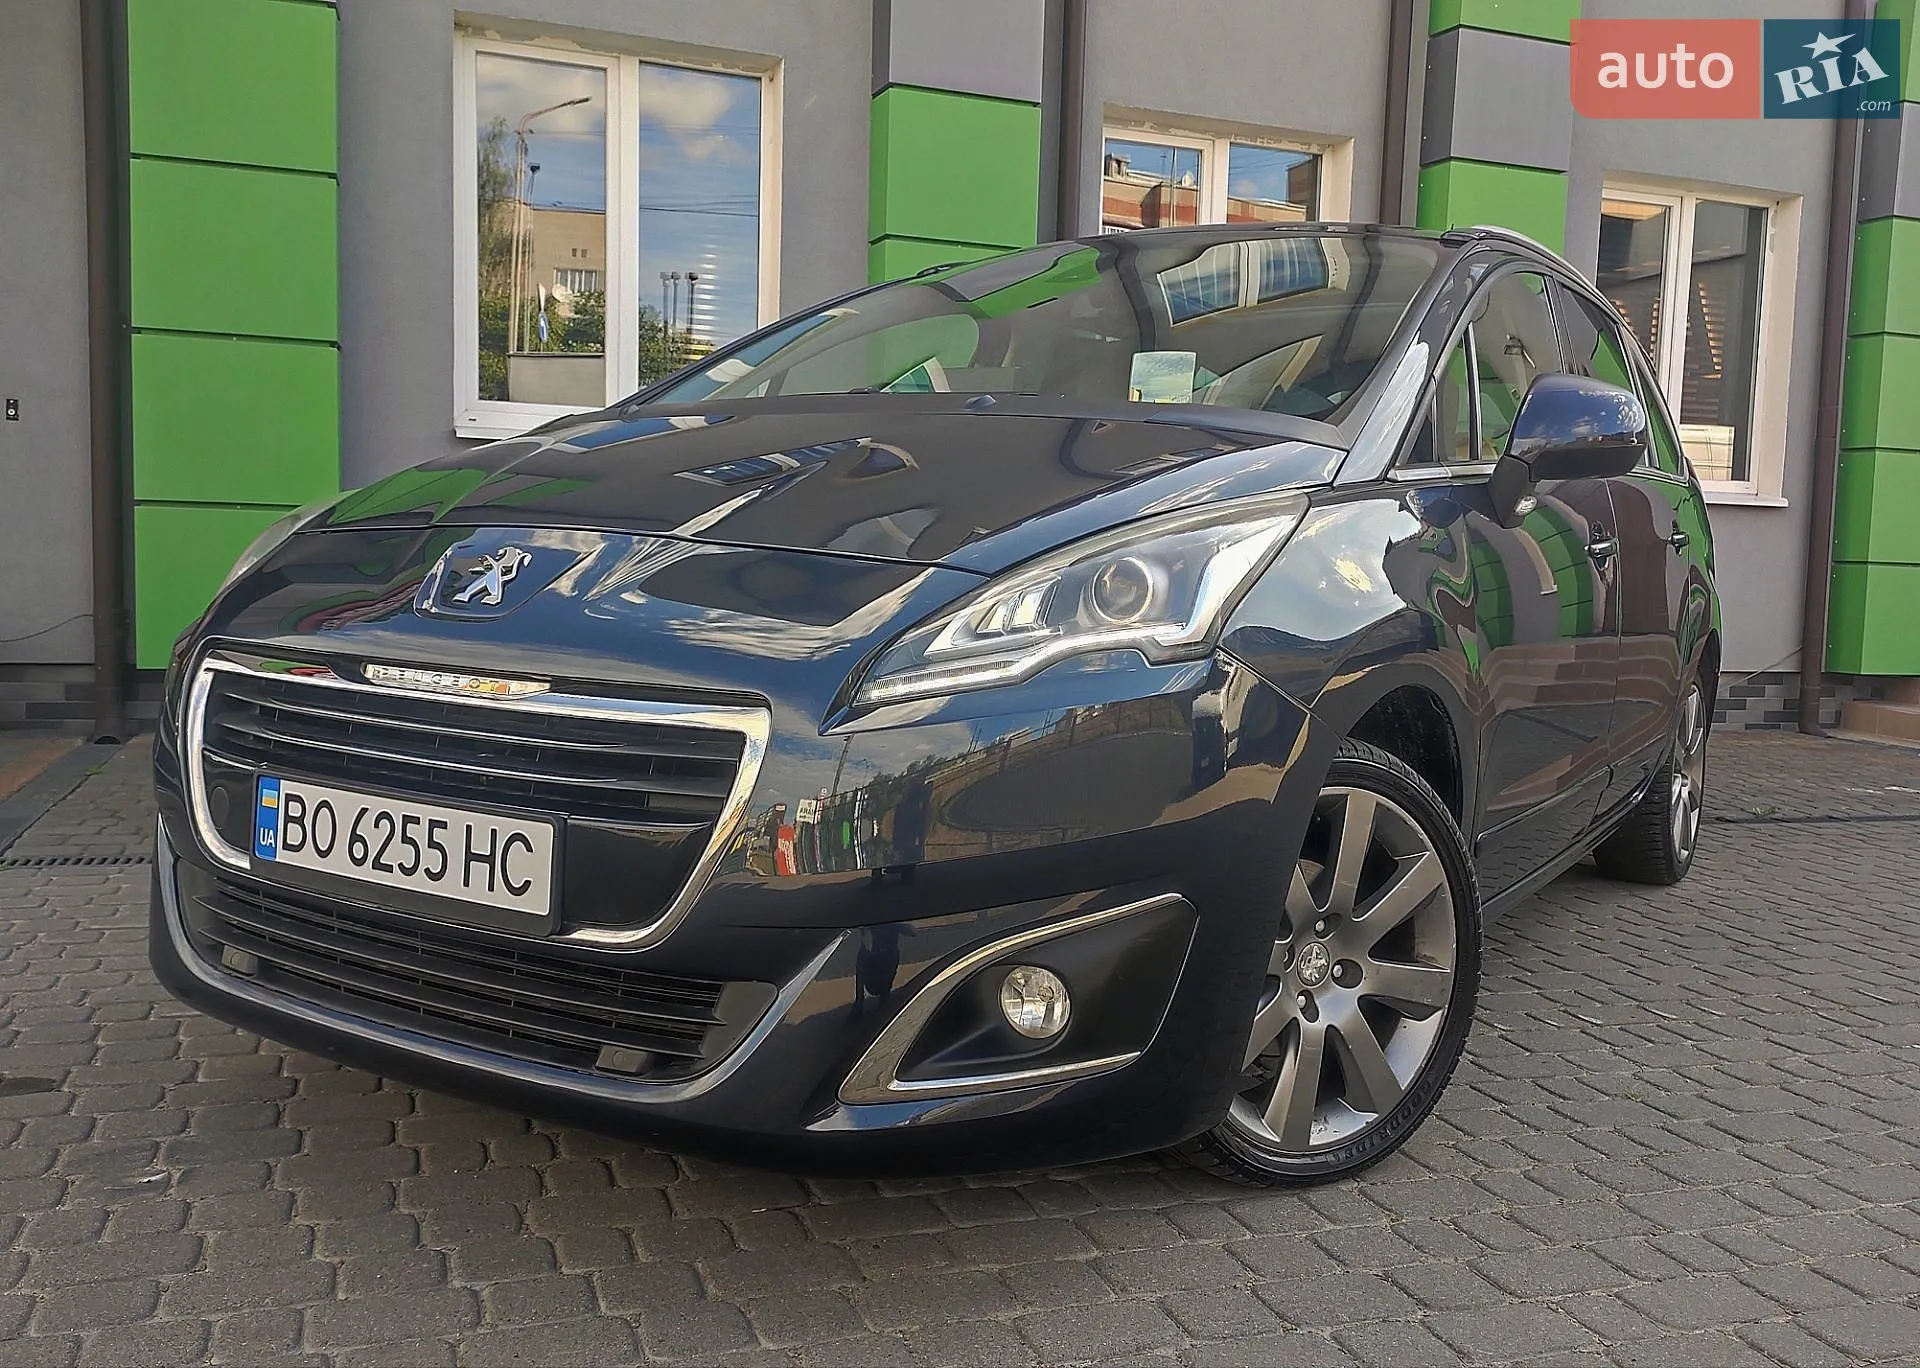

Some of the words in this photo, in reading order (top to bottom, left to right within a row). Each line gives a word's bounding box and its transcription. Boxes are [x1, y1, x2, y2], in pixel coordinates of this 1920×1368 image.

[377, 667, 500, 692] PEUGEOT
[260, 828, 276, 849] UA
[282, 792, 337, 859] BO
[347, 806, 448, 882] 6255
[463, 823, 534, 897] HC
